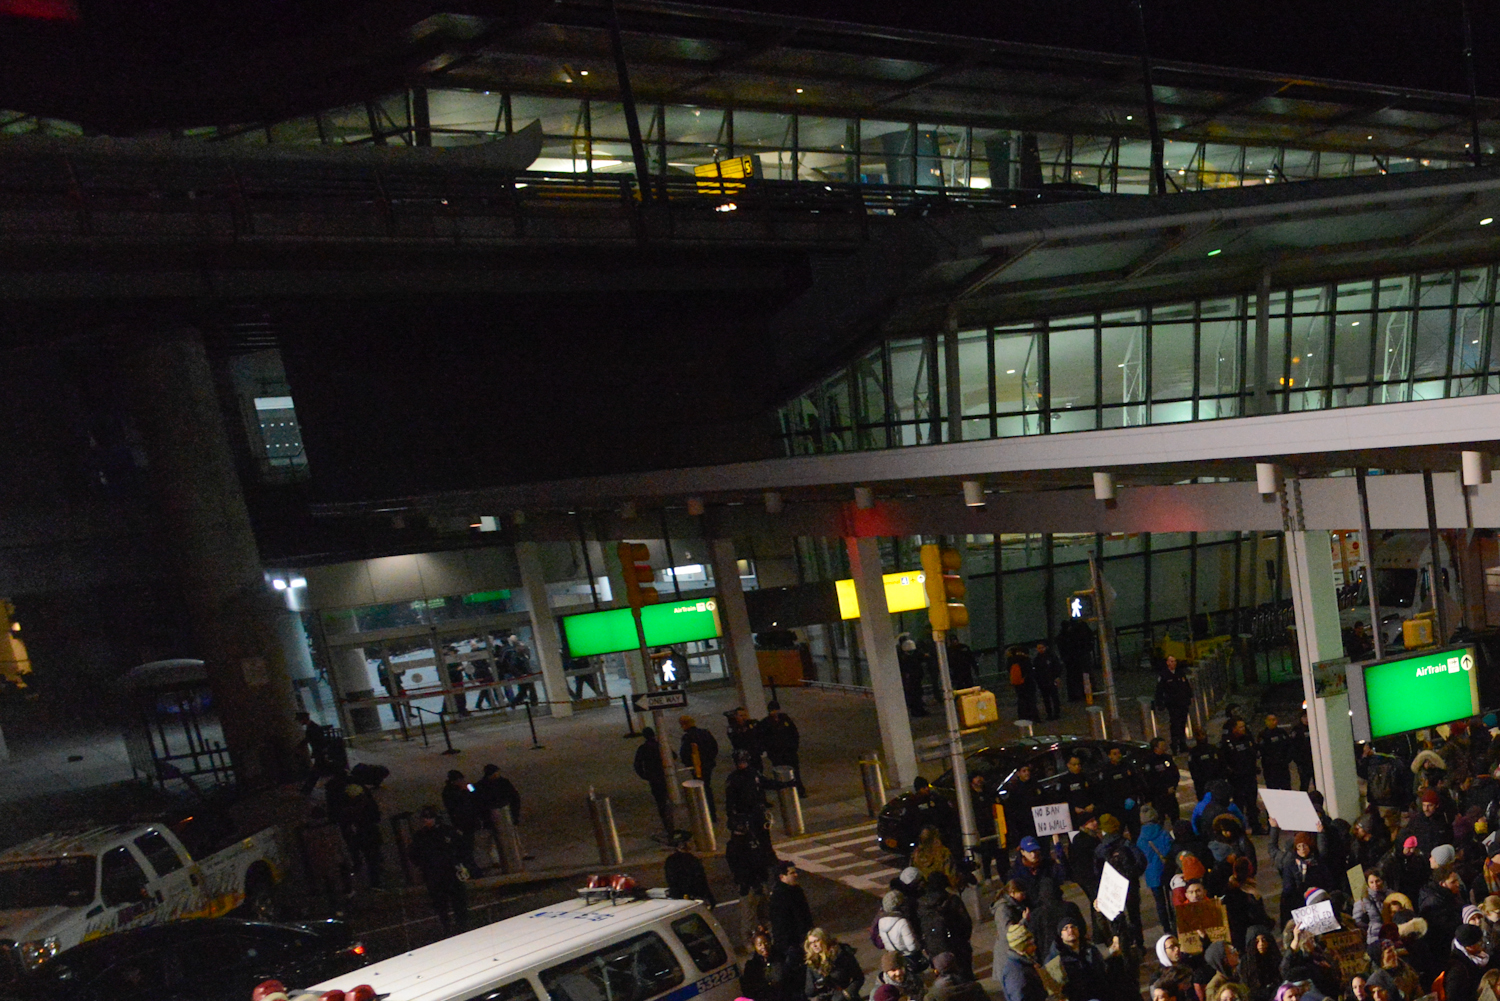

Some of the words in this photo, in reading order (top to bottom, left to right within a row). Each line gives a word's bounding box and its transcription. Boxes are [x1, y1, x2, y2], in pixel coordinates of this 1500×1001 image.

[674, 606, 697, 614] AirTrain
[1416, 663, 1447, 677] AirTrain
[649, 695, 662, 705] ONE
[666, 694, 680, 702] WAY
[1035, 808, 1042, 817] NO
[1046, 806, 1060, 816] BAN
[1038, 822, 1047, 831] NO
[1049, 820, 1067, 830] WALL
[697, 966, 736, 994] 53225
